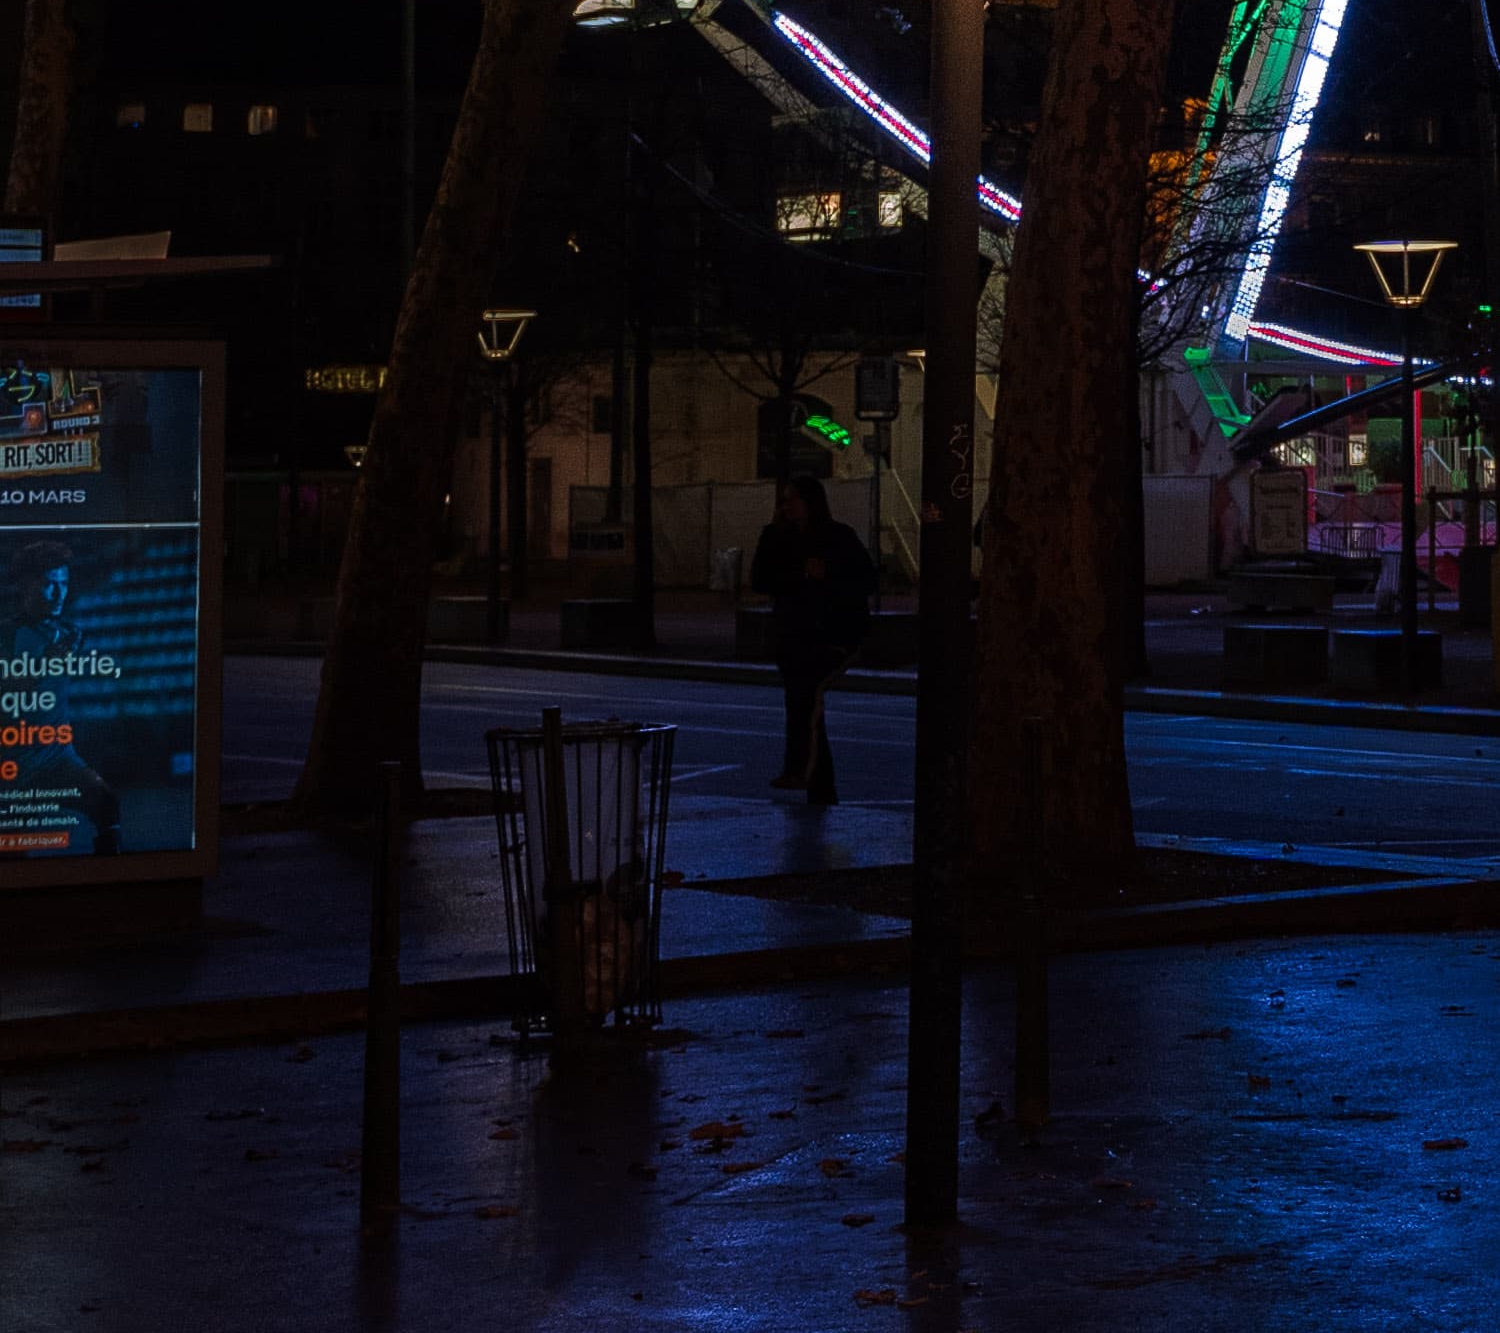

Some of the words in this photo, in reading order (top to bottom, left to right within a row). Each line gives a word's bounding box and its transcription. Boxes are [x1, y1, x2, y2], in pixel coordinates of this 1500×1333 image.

[5, 445, 32, 470] RIT,
[36, 442, 73, 466] SORT
[28, 489, 87, 504] MARS
[0, 718, 74, 746] oires
